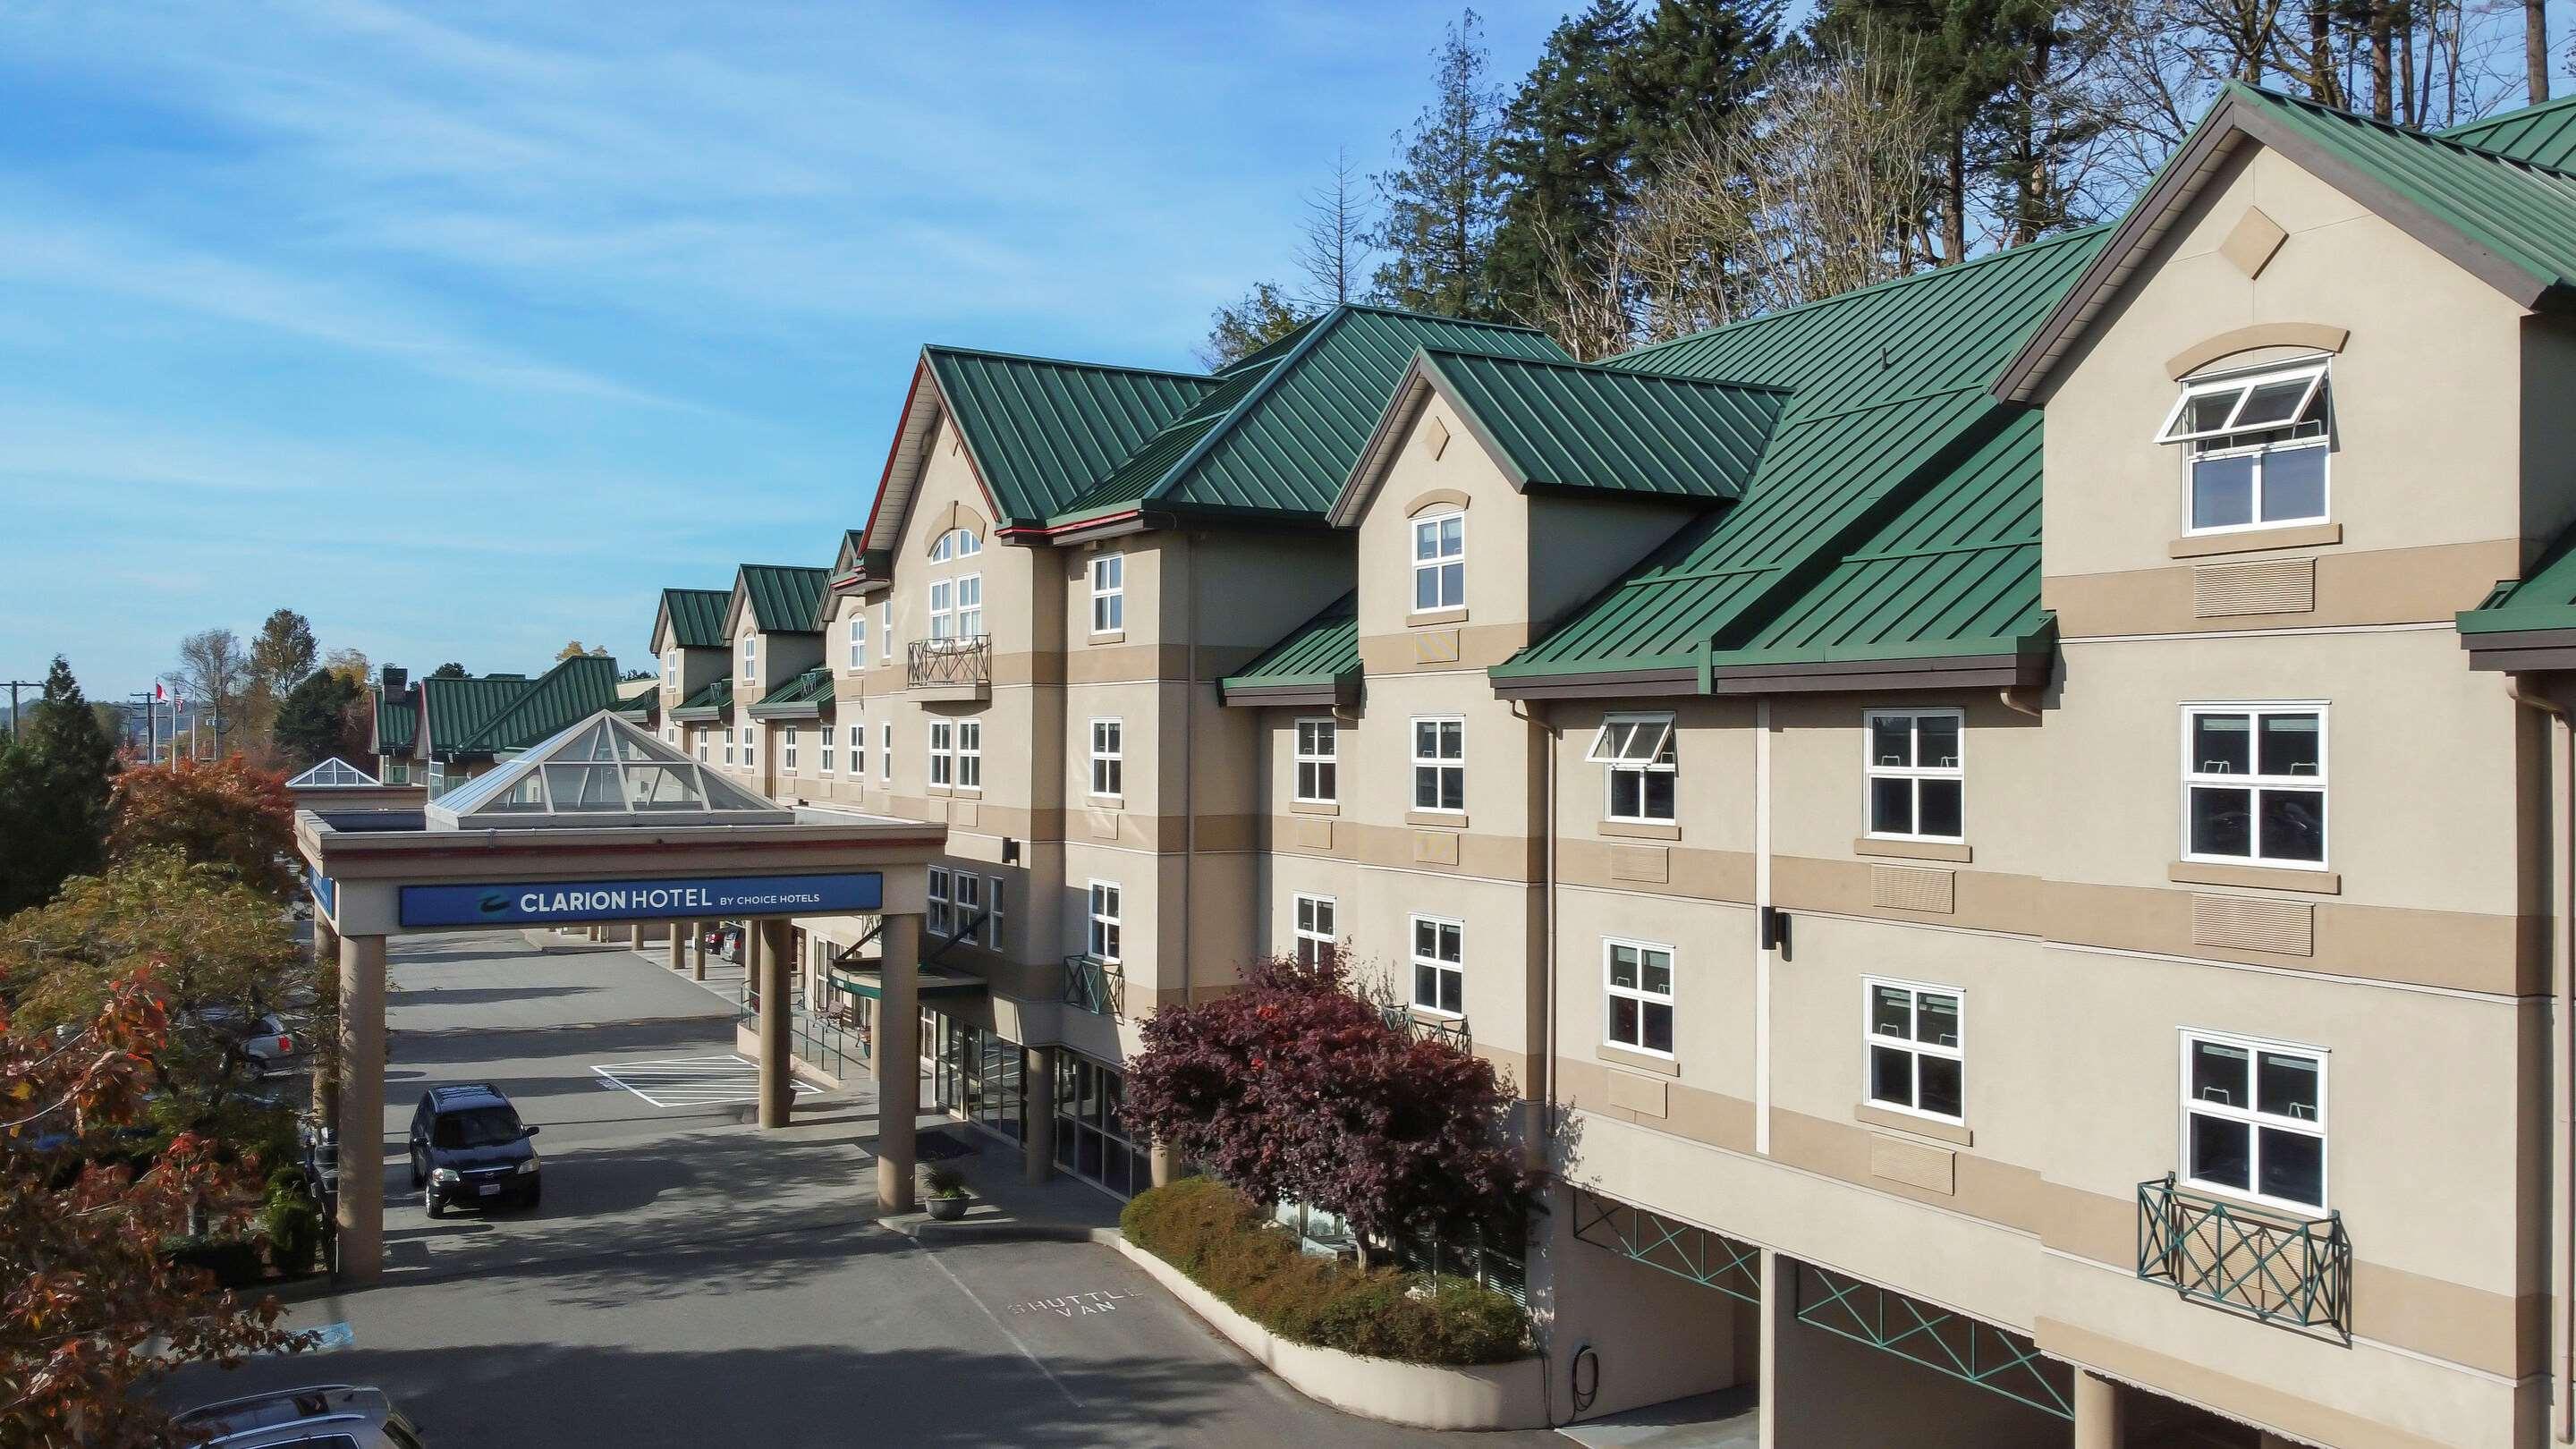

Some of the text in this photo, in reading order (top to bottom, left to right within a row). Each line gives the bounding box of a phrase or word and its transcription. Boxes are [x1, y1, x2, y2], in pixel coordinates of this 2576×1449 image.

[521, 887, 821, 912] CLARION HOTEL BY CHOICE HOTELS
[1055, 1301, 1115, 1317] VAN
